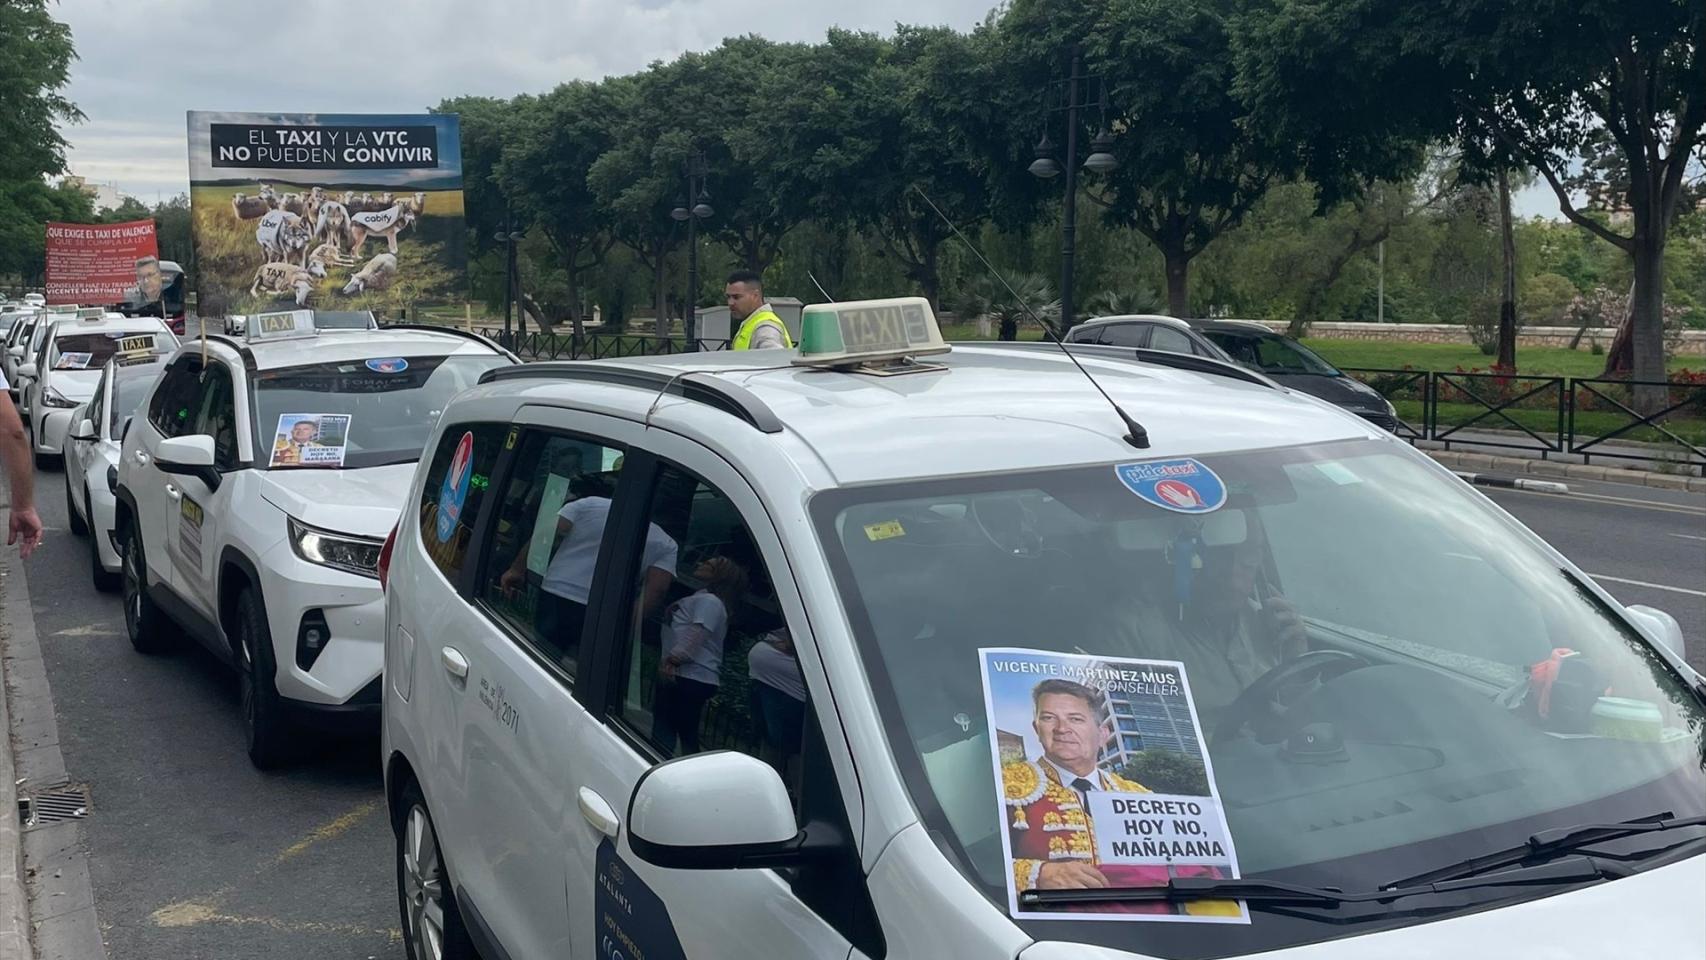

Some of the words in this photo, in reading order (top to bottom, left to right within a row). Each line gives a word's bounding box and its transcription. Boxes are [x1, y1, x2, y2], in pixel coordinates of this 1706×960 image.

[249, 129, 270, 145] EL
[275, 129, 321, 145] TAXI
[327, 131, 339, 146] Y
[345, 131, 368, 146] LA
[371, 130, 408, 146] VTC
[219, 145, 251, 161] NO
[257, 146, 336, 162] PUEDEN
[342, 147, 433, 162] CONVIVIR
[364, 214, 392, 225] cabify
[64, 228, 85, 239] EXIGE
[86, 229, 94, 239] EL
[94, 229, 111, 239] TAXI
[111, 228, 121, 238] DE
[265, 267, 287, 279] TAXI
[46, 287, 80, 295] VICENTE
[261, 314, 294, 332] TAXI
[842, 307, 903, 345] TAXI
[123, 336, 146, 351] TAXI
[993, 660, 1058, 676] VICENTE
[1062, 664, 1140, 683] MARTINEZ
[1141, 671, 1176, 685] MUS
[1096, 679, 1179, 697] CONSELLER
[501, 701, 520, 735] 2071
[1111, 798, 1202, 816] DECRETO
[1123, 819, 1165, 836] HOY
[1173, 820, 1208, 838] NO,
[598, 872, 633, 915] ATALANTA
